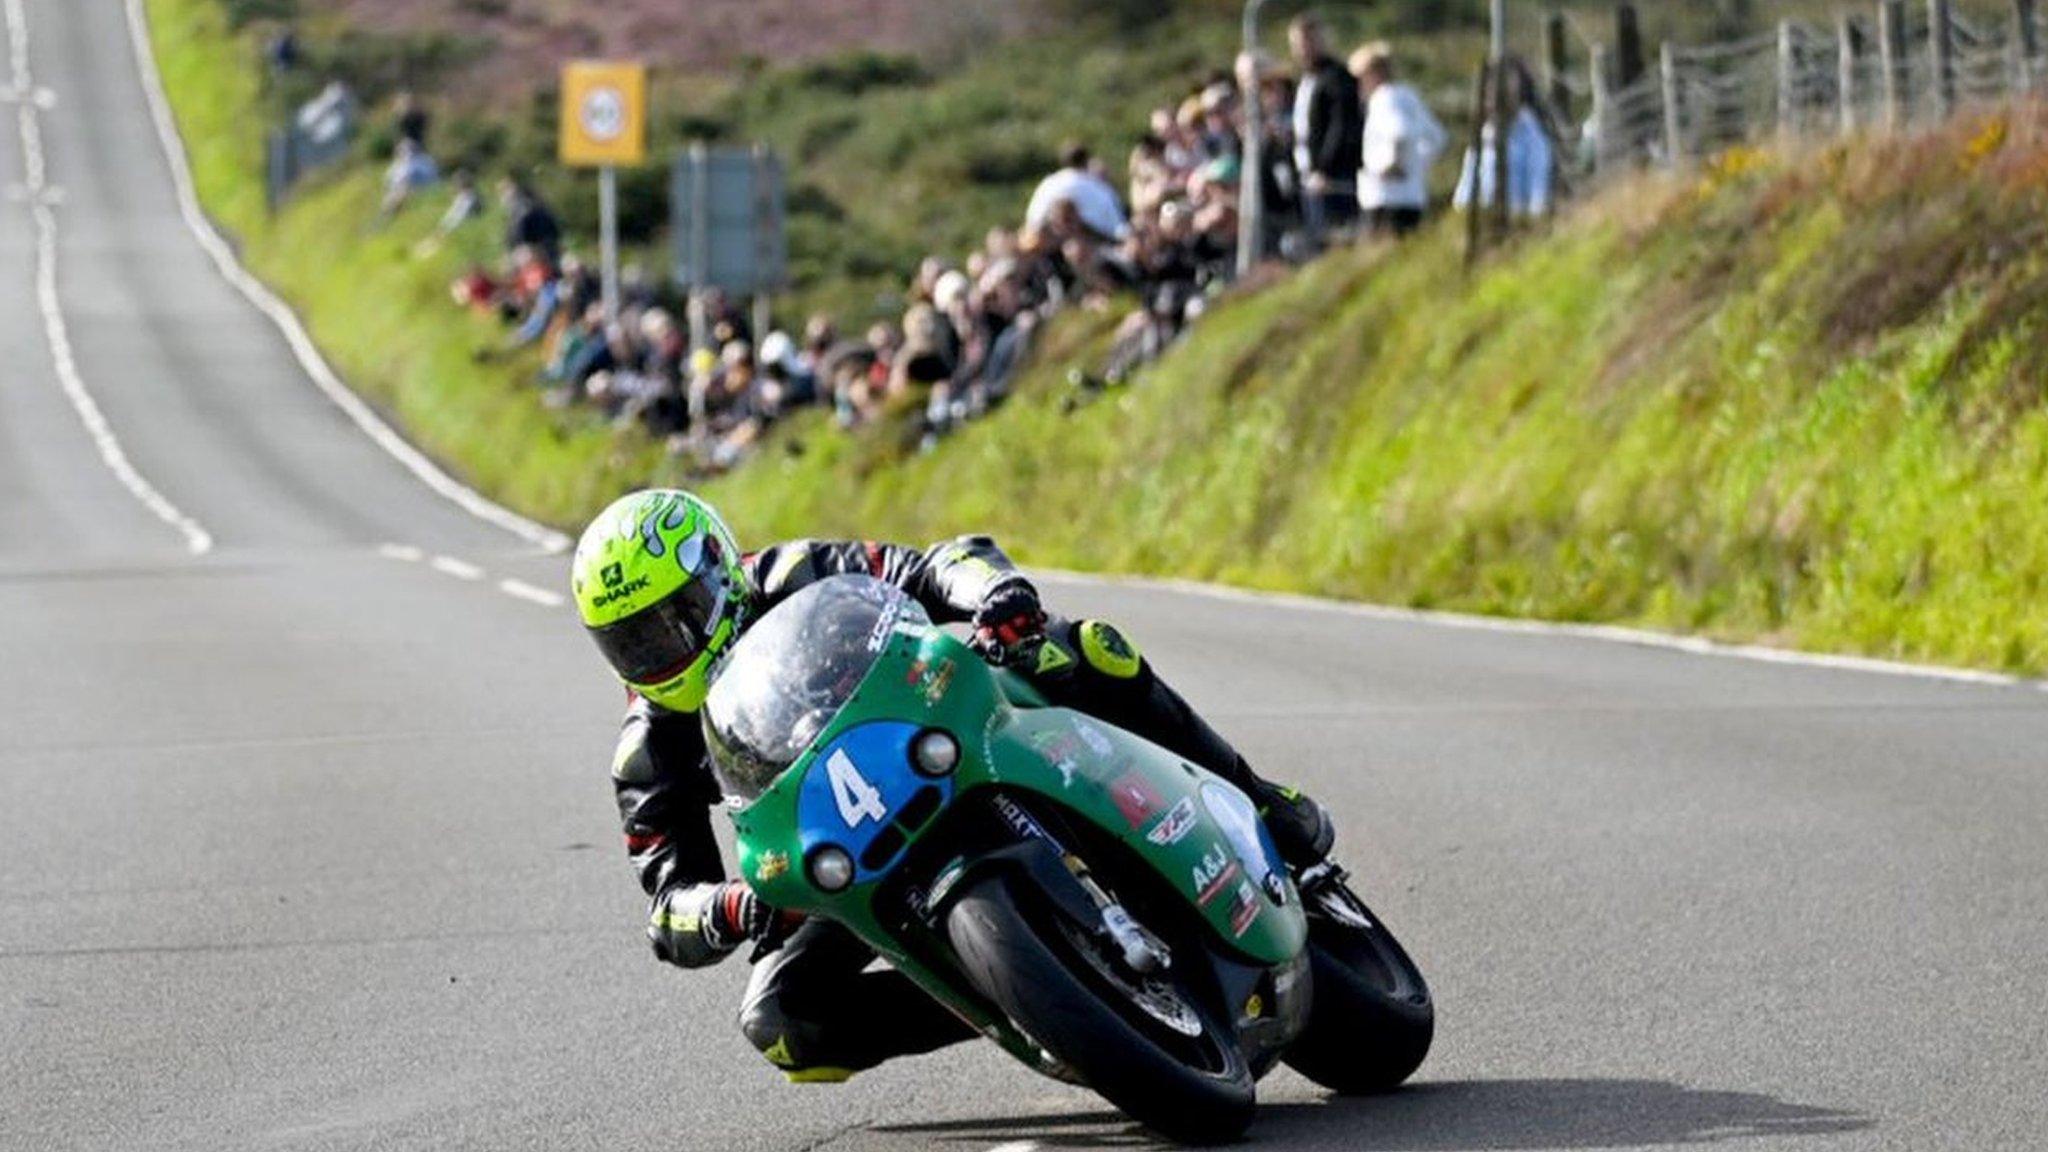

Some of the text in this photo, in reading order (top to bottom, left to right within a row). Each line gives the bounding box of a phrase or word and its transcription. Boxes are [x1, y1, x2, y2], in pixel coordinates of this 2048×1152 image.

[592, 574, 651, 608] SHARK
[826, 748, 887, 828] 4
[992, 793, 1043, 838] MAXT
[1192, 842, 1227, 893] A&J
